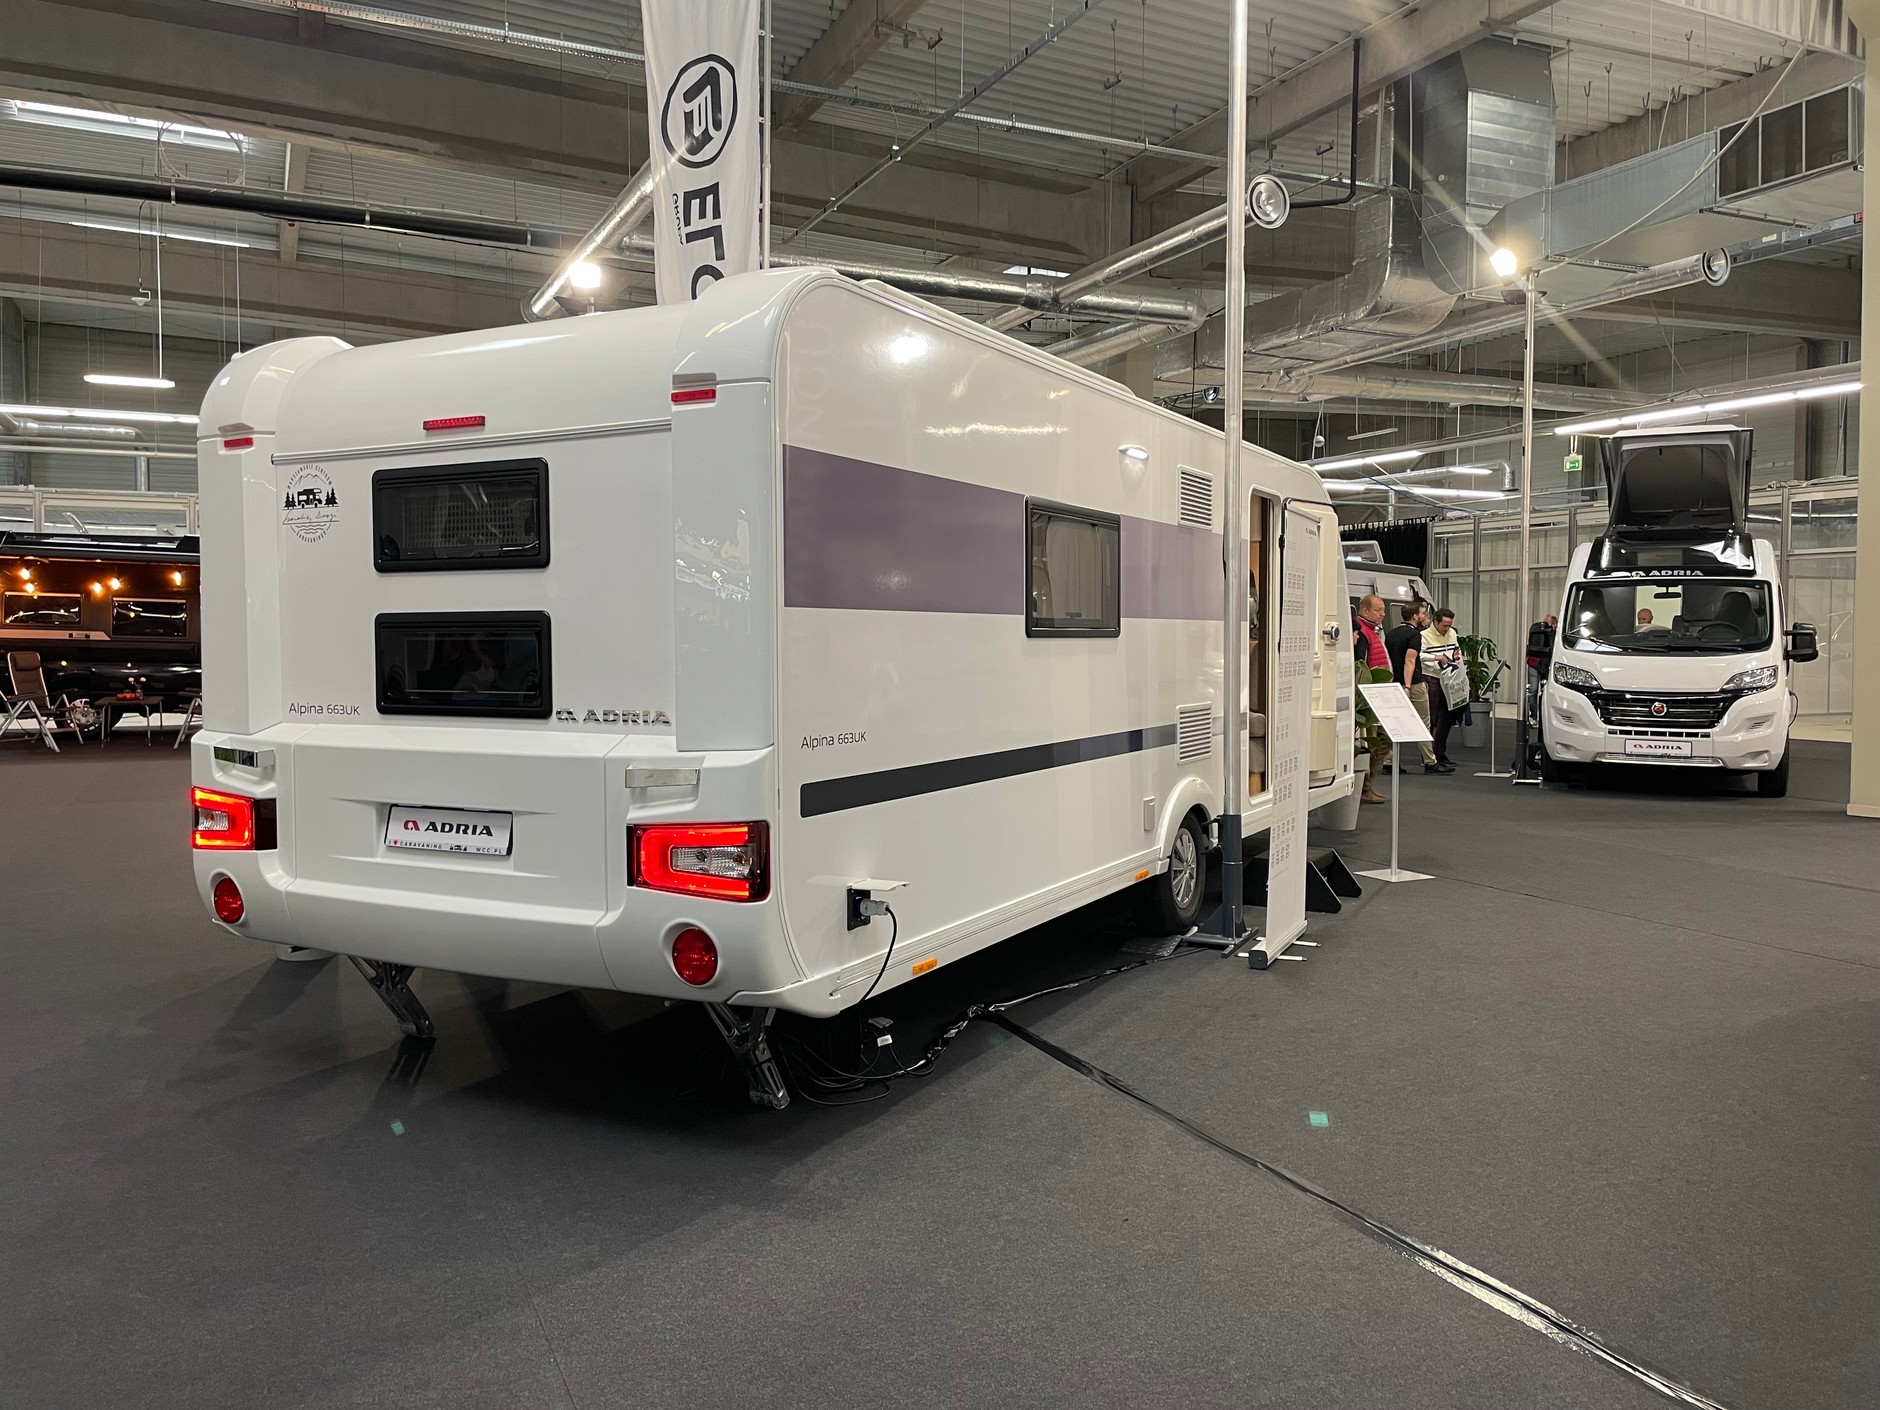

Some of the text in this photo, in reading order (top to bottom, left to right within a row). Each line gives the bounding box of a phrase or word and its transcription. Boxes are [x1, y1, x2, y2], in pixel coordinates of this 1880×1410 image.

[288, 702, 360, 716] Alpina 663UK
[583, 708, 672, 726] ADRIA
[800, 731, 867, 751] Alpina 663UK
[424, 821, 494, 837] ADRIA
[399, 841, 442, 849] CARAVANING
